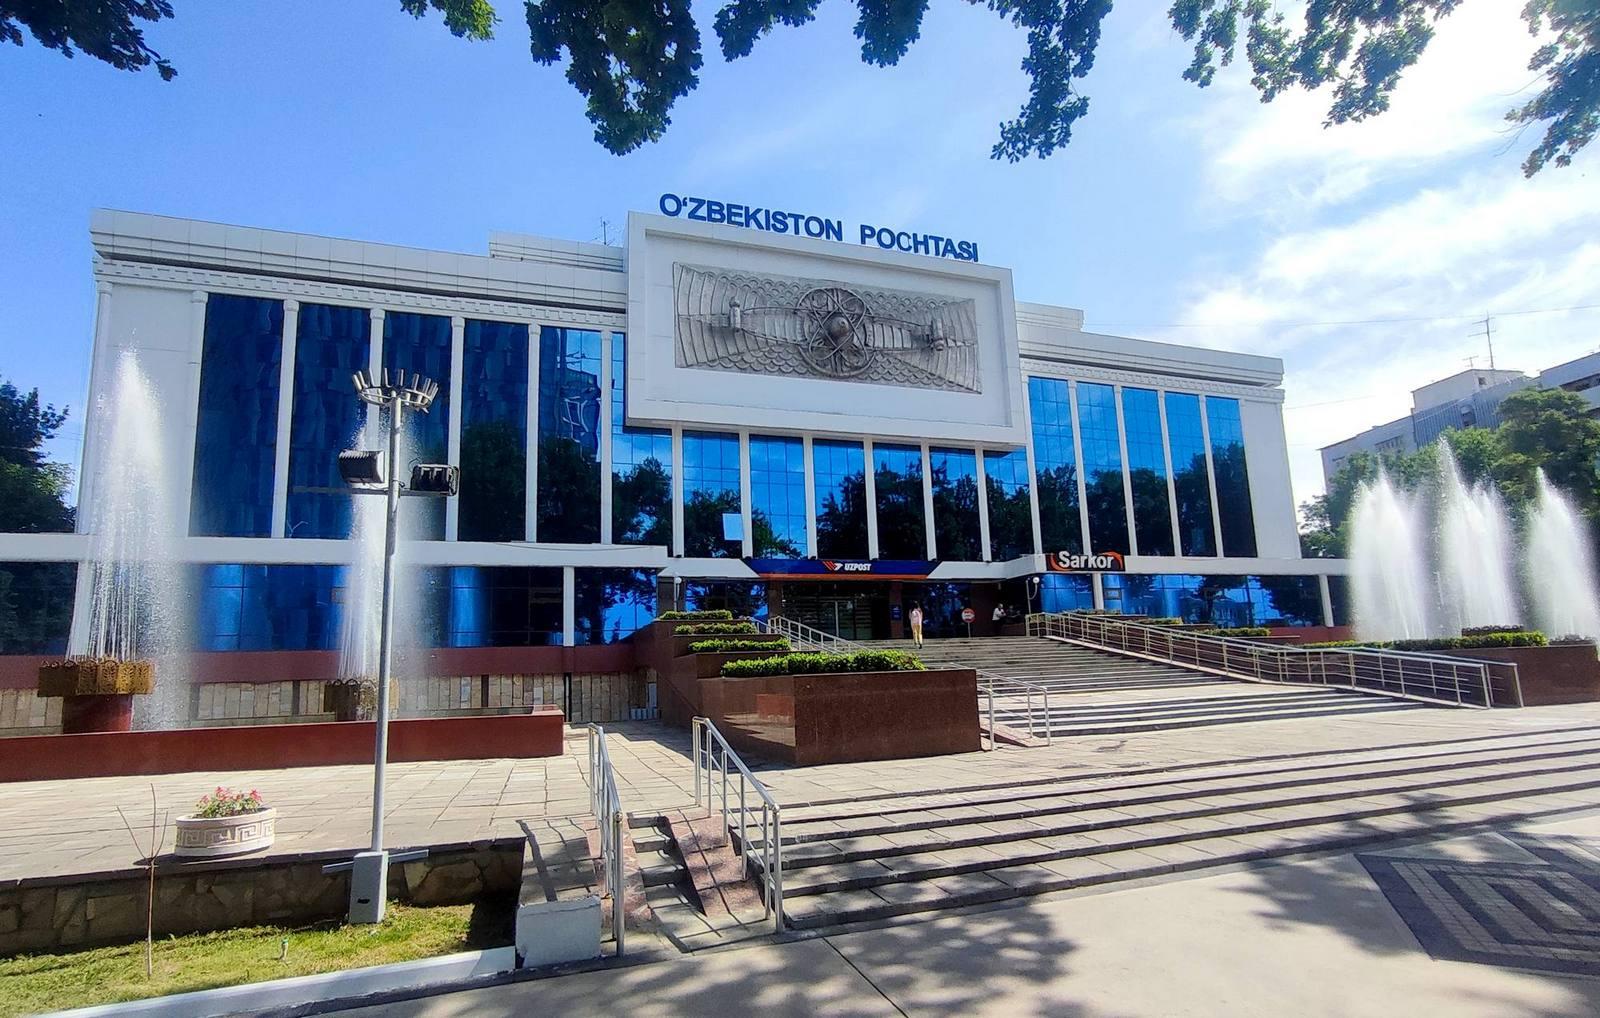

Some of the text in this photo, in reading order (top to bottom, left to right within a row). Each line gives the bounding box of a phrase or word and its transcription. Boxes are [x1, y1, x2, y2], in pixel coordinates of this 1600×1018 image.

[860, 224, 979, 263] POCHTASI
[844, 563, 872, 571] UZPOST
[1058, 550, 1114, 569] Sarkor
